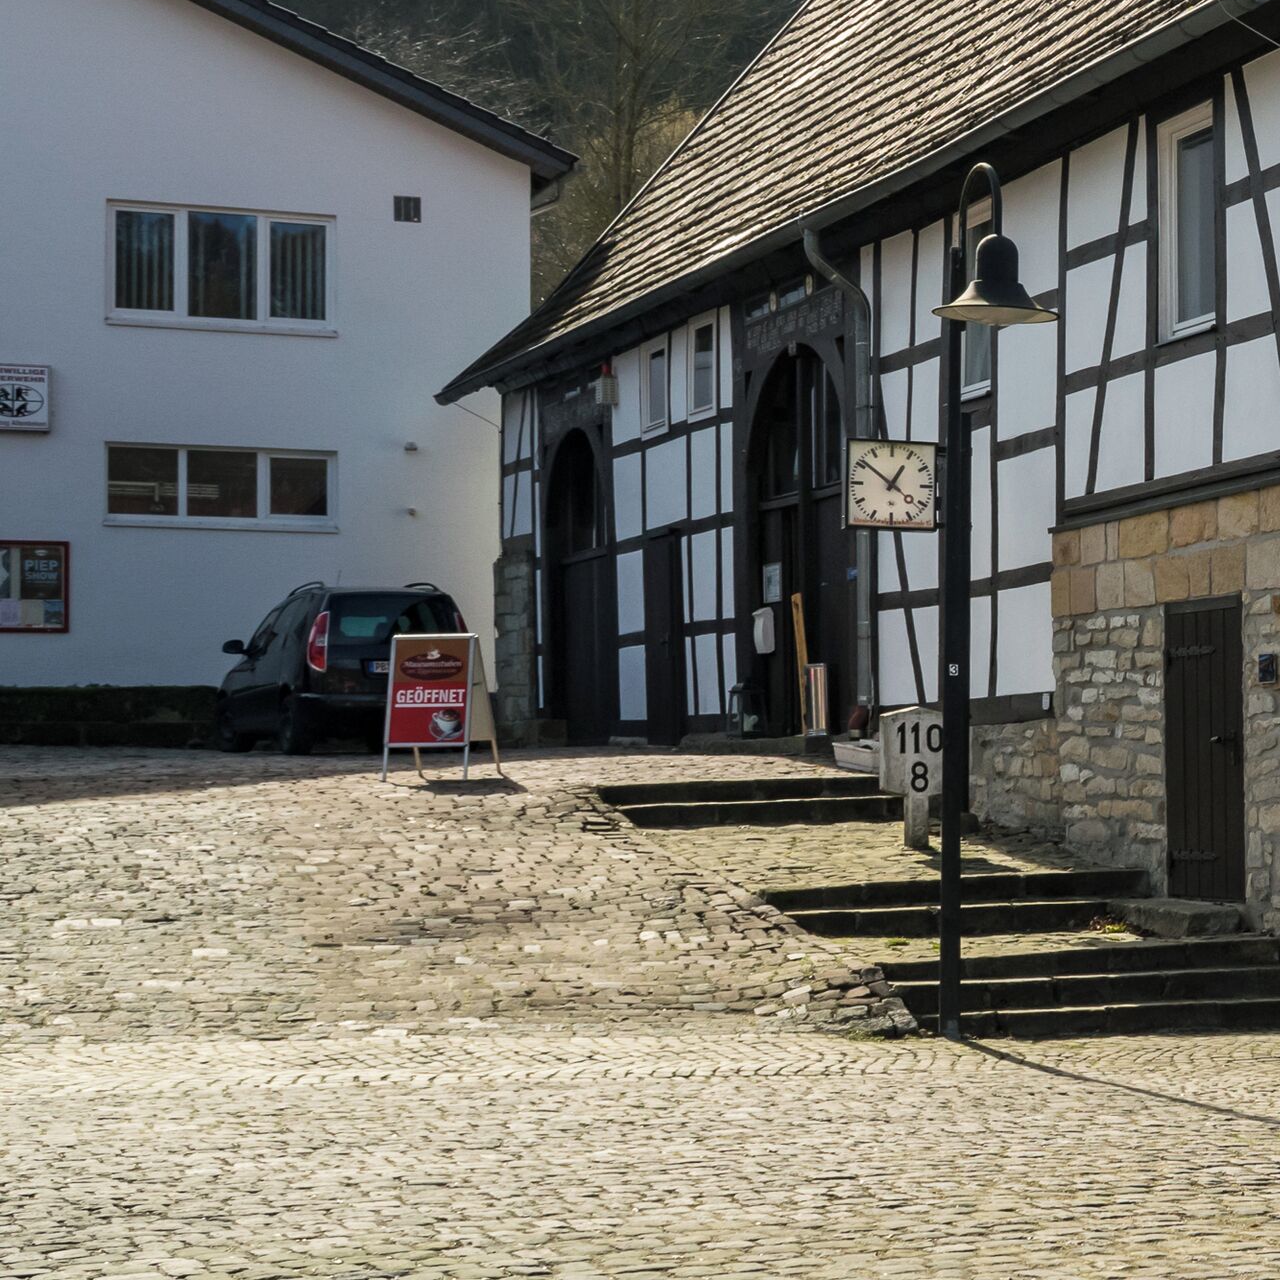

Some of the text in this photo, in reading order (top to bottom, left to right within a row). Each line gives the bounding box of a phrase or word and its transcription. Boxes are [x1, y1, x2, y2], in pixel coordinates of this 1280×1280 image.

[24, 560, 58, 571] PIEP
[24, 571, 58, 580] SHOW
[950, 664, 958, 676] 3
[396, 686, 466, 703] GEÖFFNET
[896, 721, 943, 754] 110
[910, 761, 928, 793] 8
